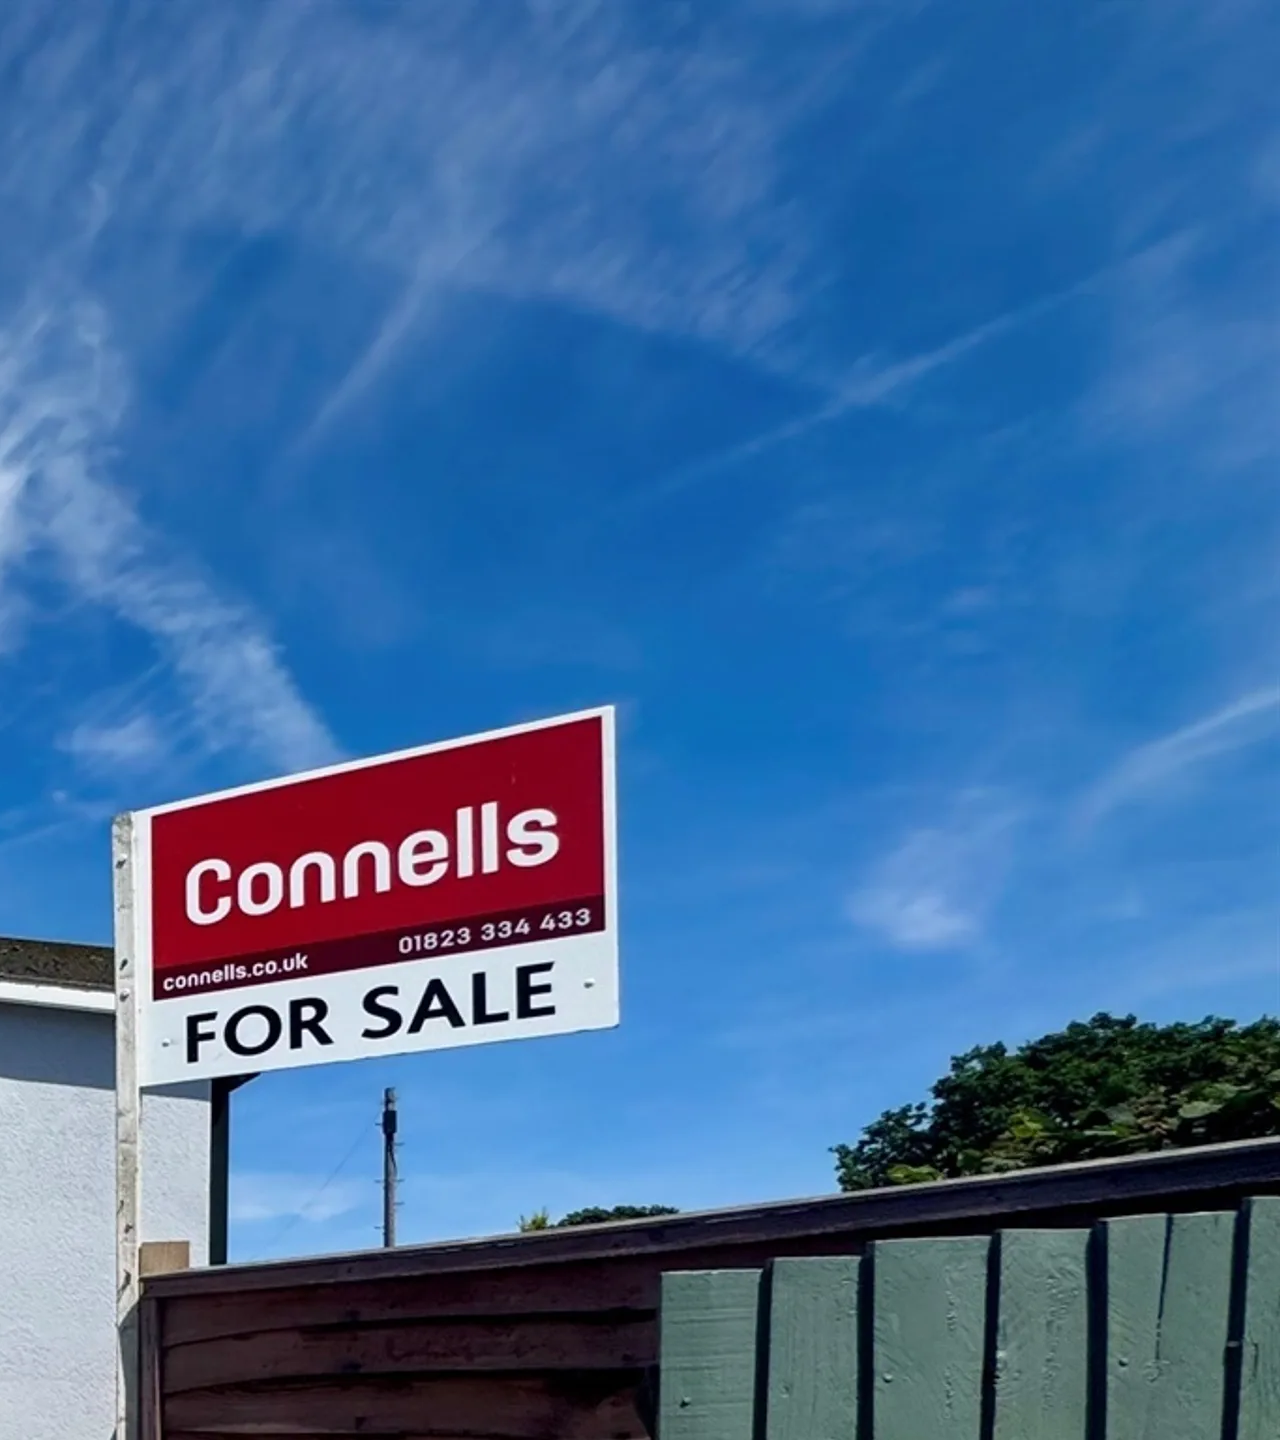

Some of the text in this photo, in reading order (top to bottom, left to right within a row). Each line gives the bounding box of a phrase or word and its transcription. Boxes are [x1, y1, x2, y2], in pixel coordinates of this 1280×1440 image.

[185, 802, 559, 925] Connells
[399, 908, 591, 954] 01823 334 433
[163, 952, 308, 990] connells.co.uk
[186, 962, 556, 1063] FOR SALE
